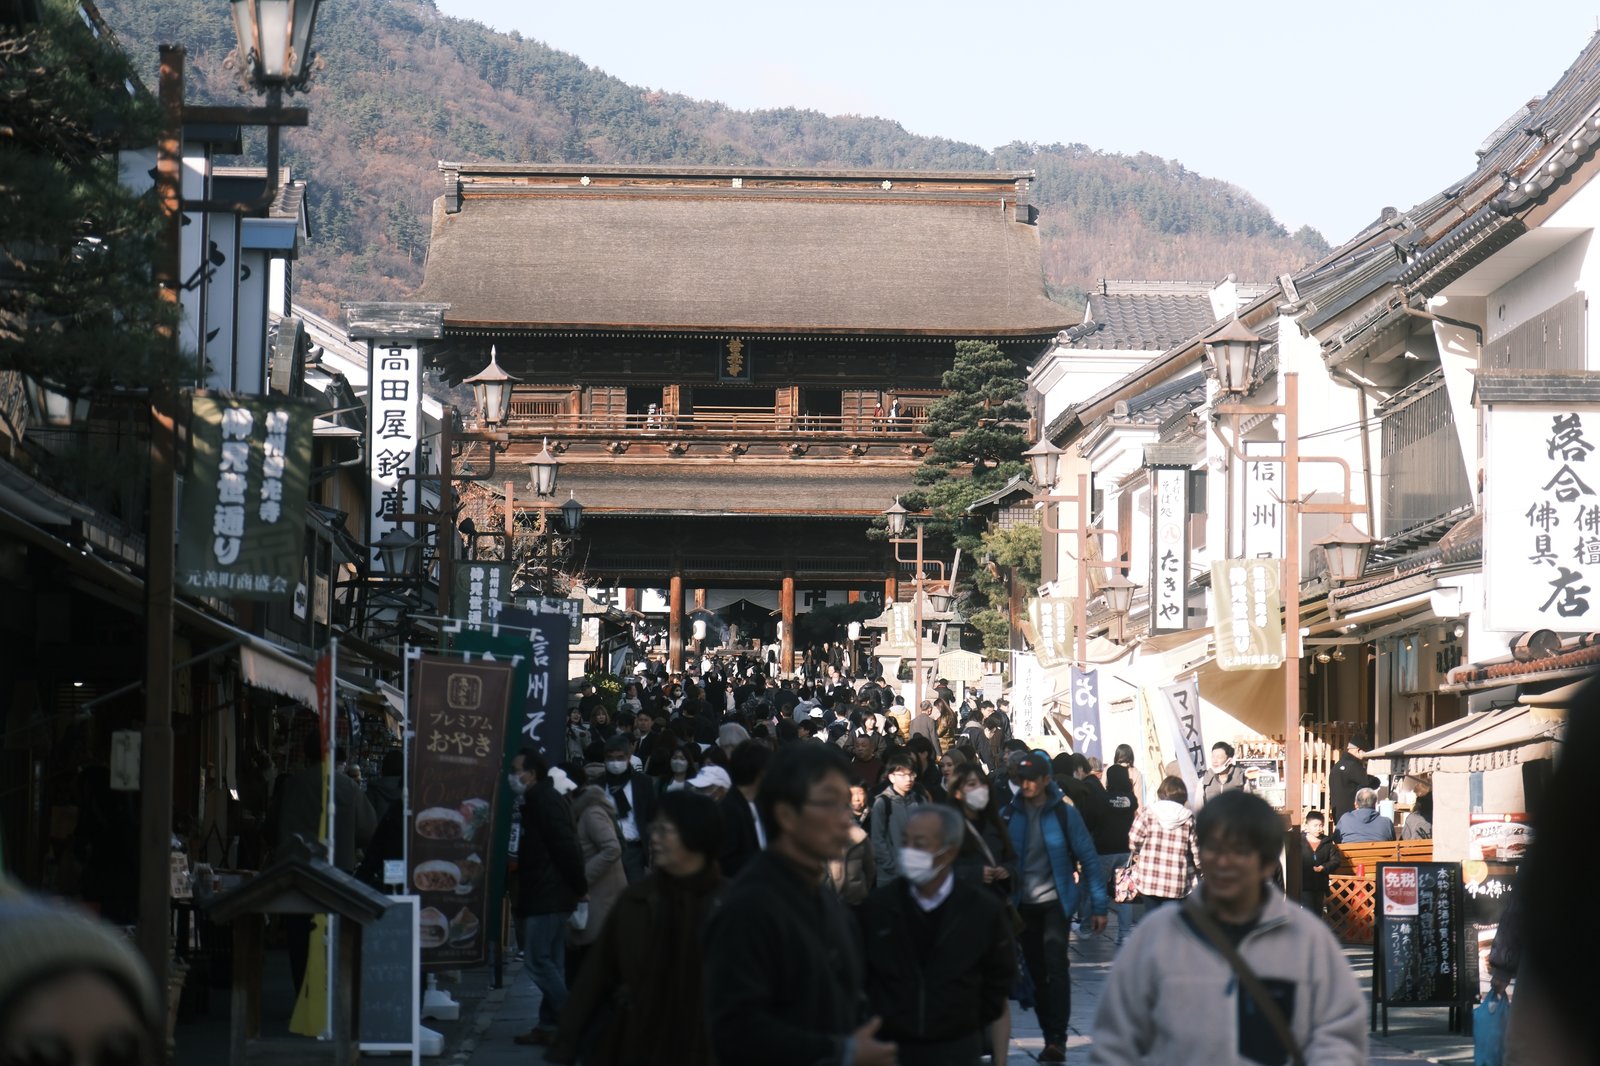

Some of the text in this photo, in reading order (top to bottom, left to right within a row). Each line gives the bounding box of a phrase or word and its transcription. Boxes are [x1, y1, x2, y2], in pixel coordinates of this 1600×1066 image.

[375, 341, 412, 561] 高田屋銘産
[1541, 412, 1597, 503] 落合
[1160, 480, 1173, 518] そば処
[1252, 455, 1277, 559] 信州
[1525, 500, 1560, 567] 佛具
[1159, 549, 1181, 621] たきや
[1538, 566, 1592, 618] 店
[430, 710, 493, 731] プレミアム
[521, 634, 549, 755] 信州そ
[1073, 677, 1098, 754] おや
[427, 728, 492, 757] おやき
[1385, 872, 1416, 889] 免税
[1391, 924, 1401, 957] ソラリス
